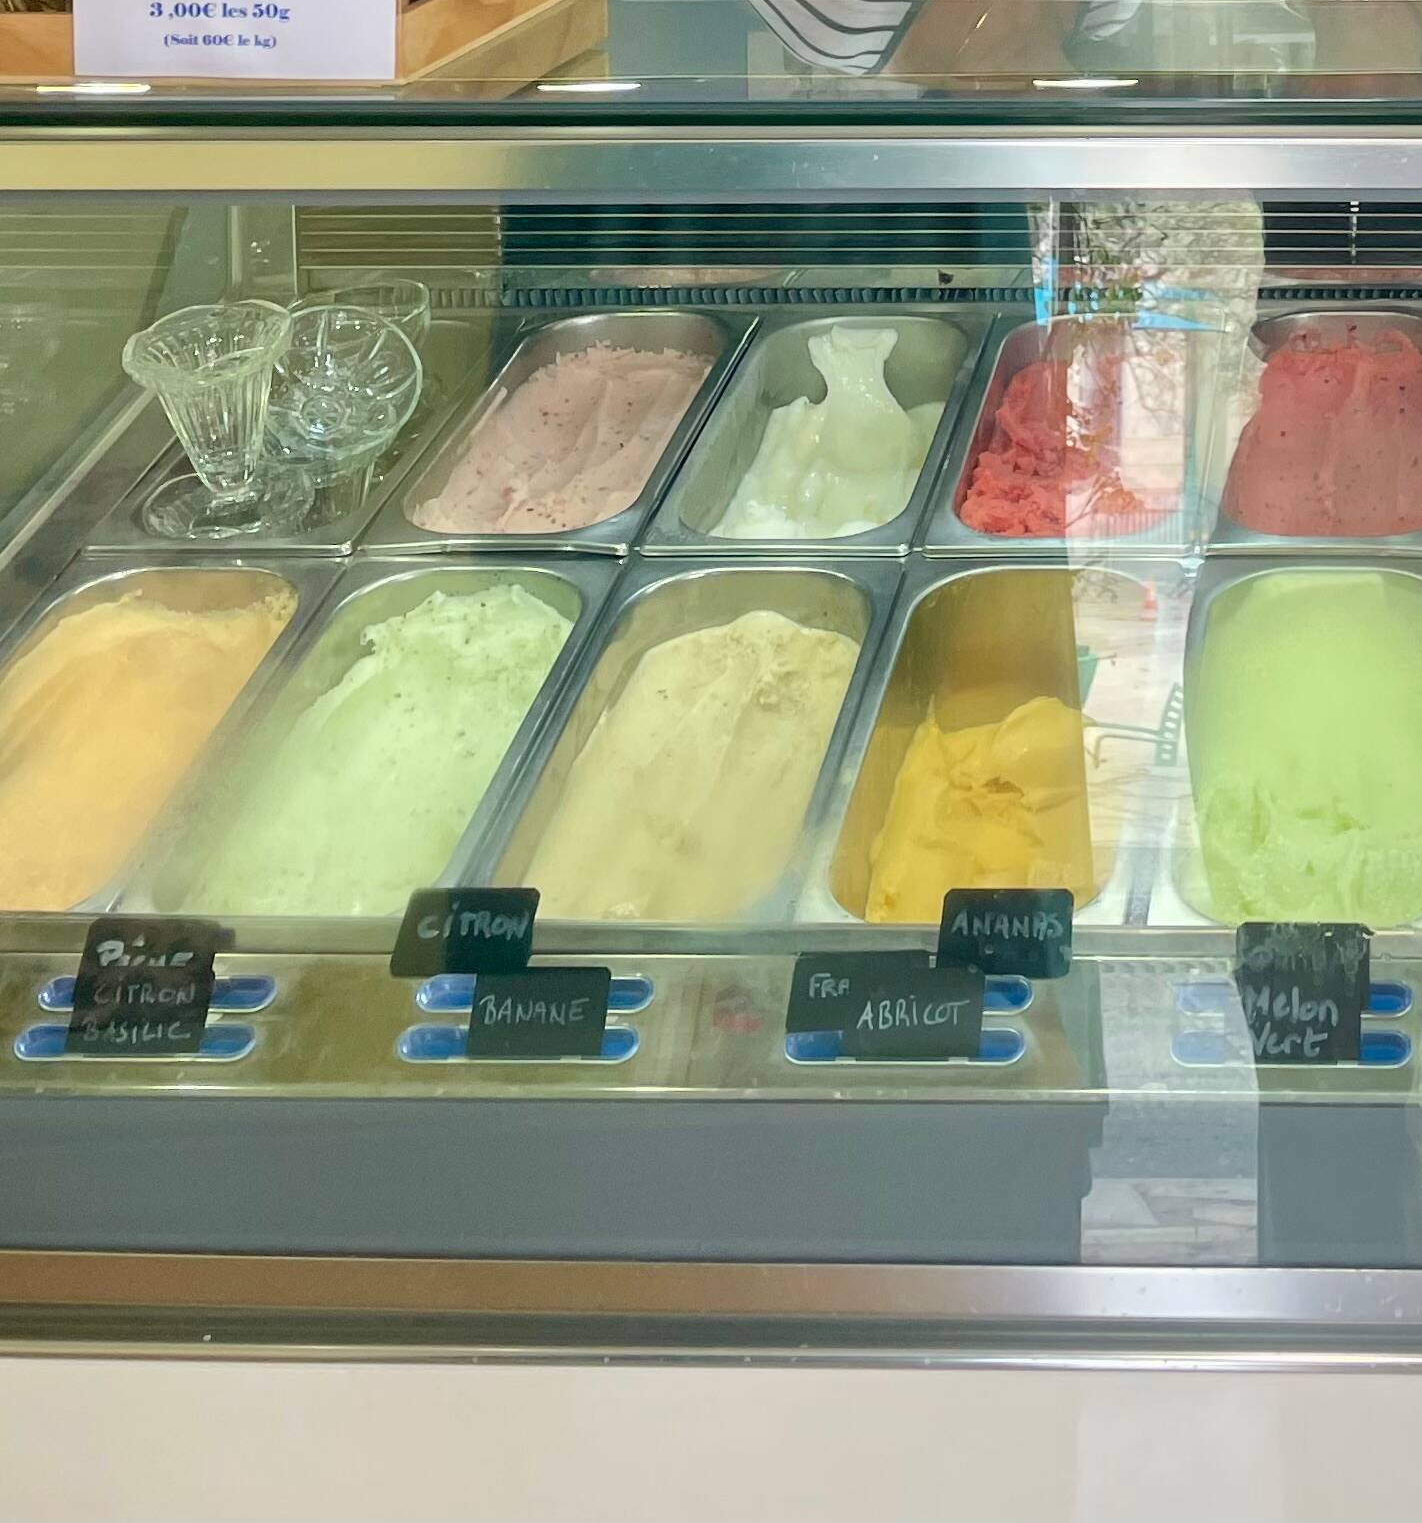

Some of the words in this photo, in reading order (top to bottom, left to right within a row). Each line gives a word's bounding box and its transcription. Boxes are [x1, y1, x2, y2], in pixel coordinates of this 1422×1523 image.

[222, 3, 247, 18] les
[252, 3, 290, 21] 50g
[164, 34, 198, 48] (Soit
[202, 34, 233, 46] 60€
[238, 34, 249, 46] le
[254, 34, 276, 48] kg)
[953, 910, 1063, 940] ANANAS
[480, 995, 589, 1025] BANANE
[1245, 986, 1338, 1026] Melon
[82, 1021, 190, 1044] BASILIC
